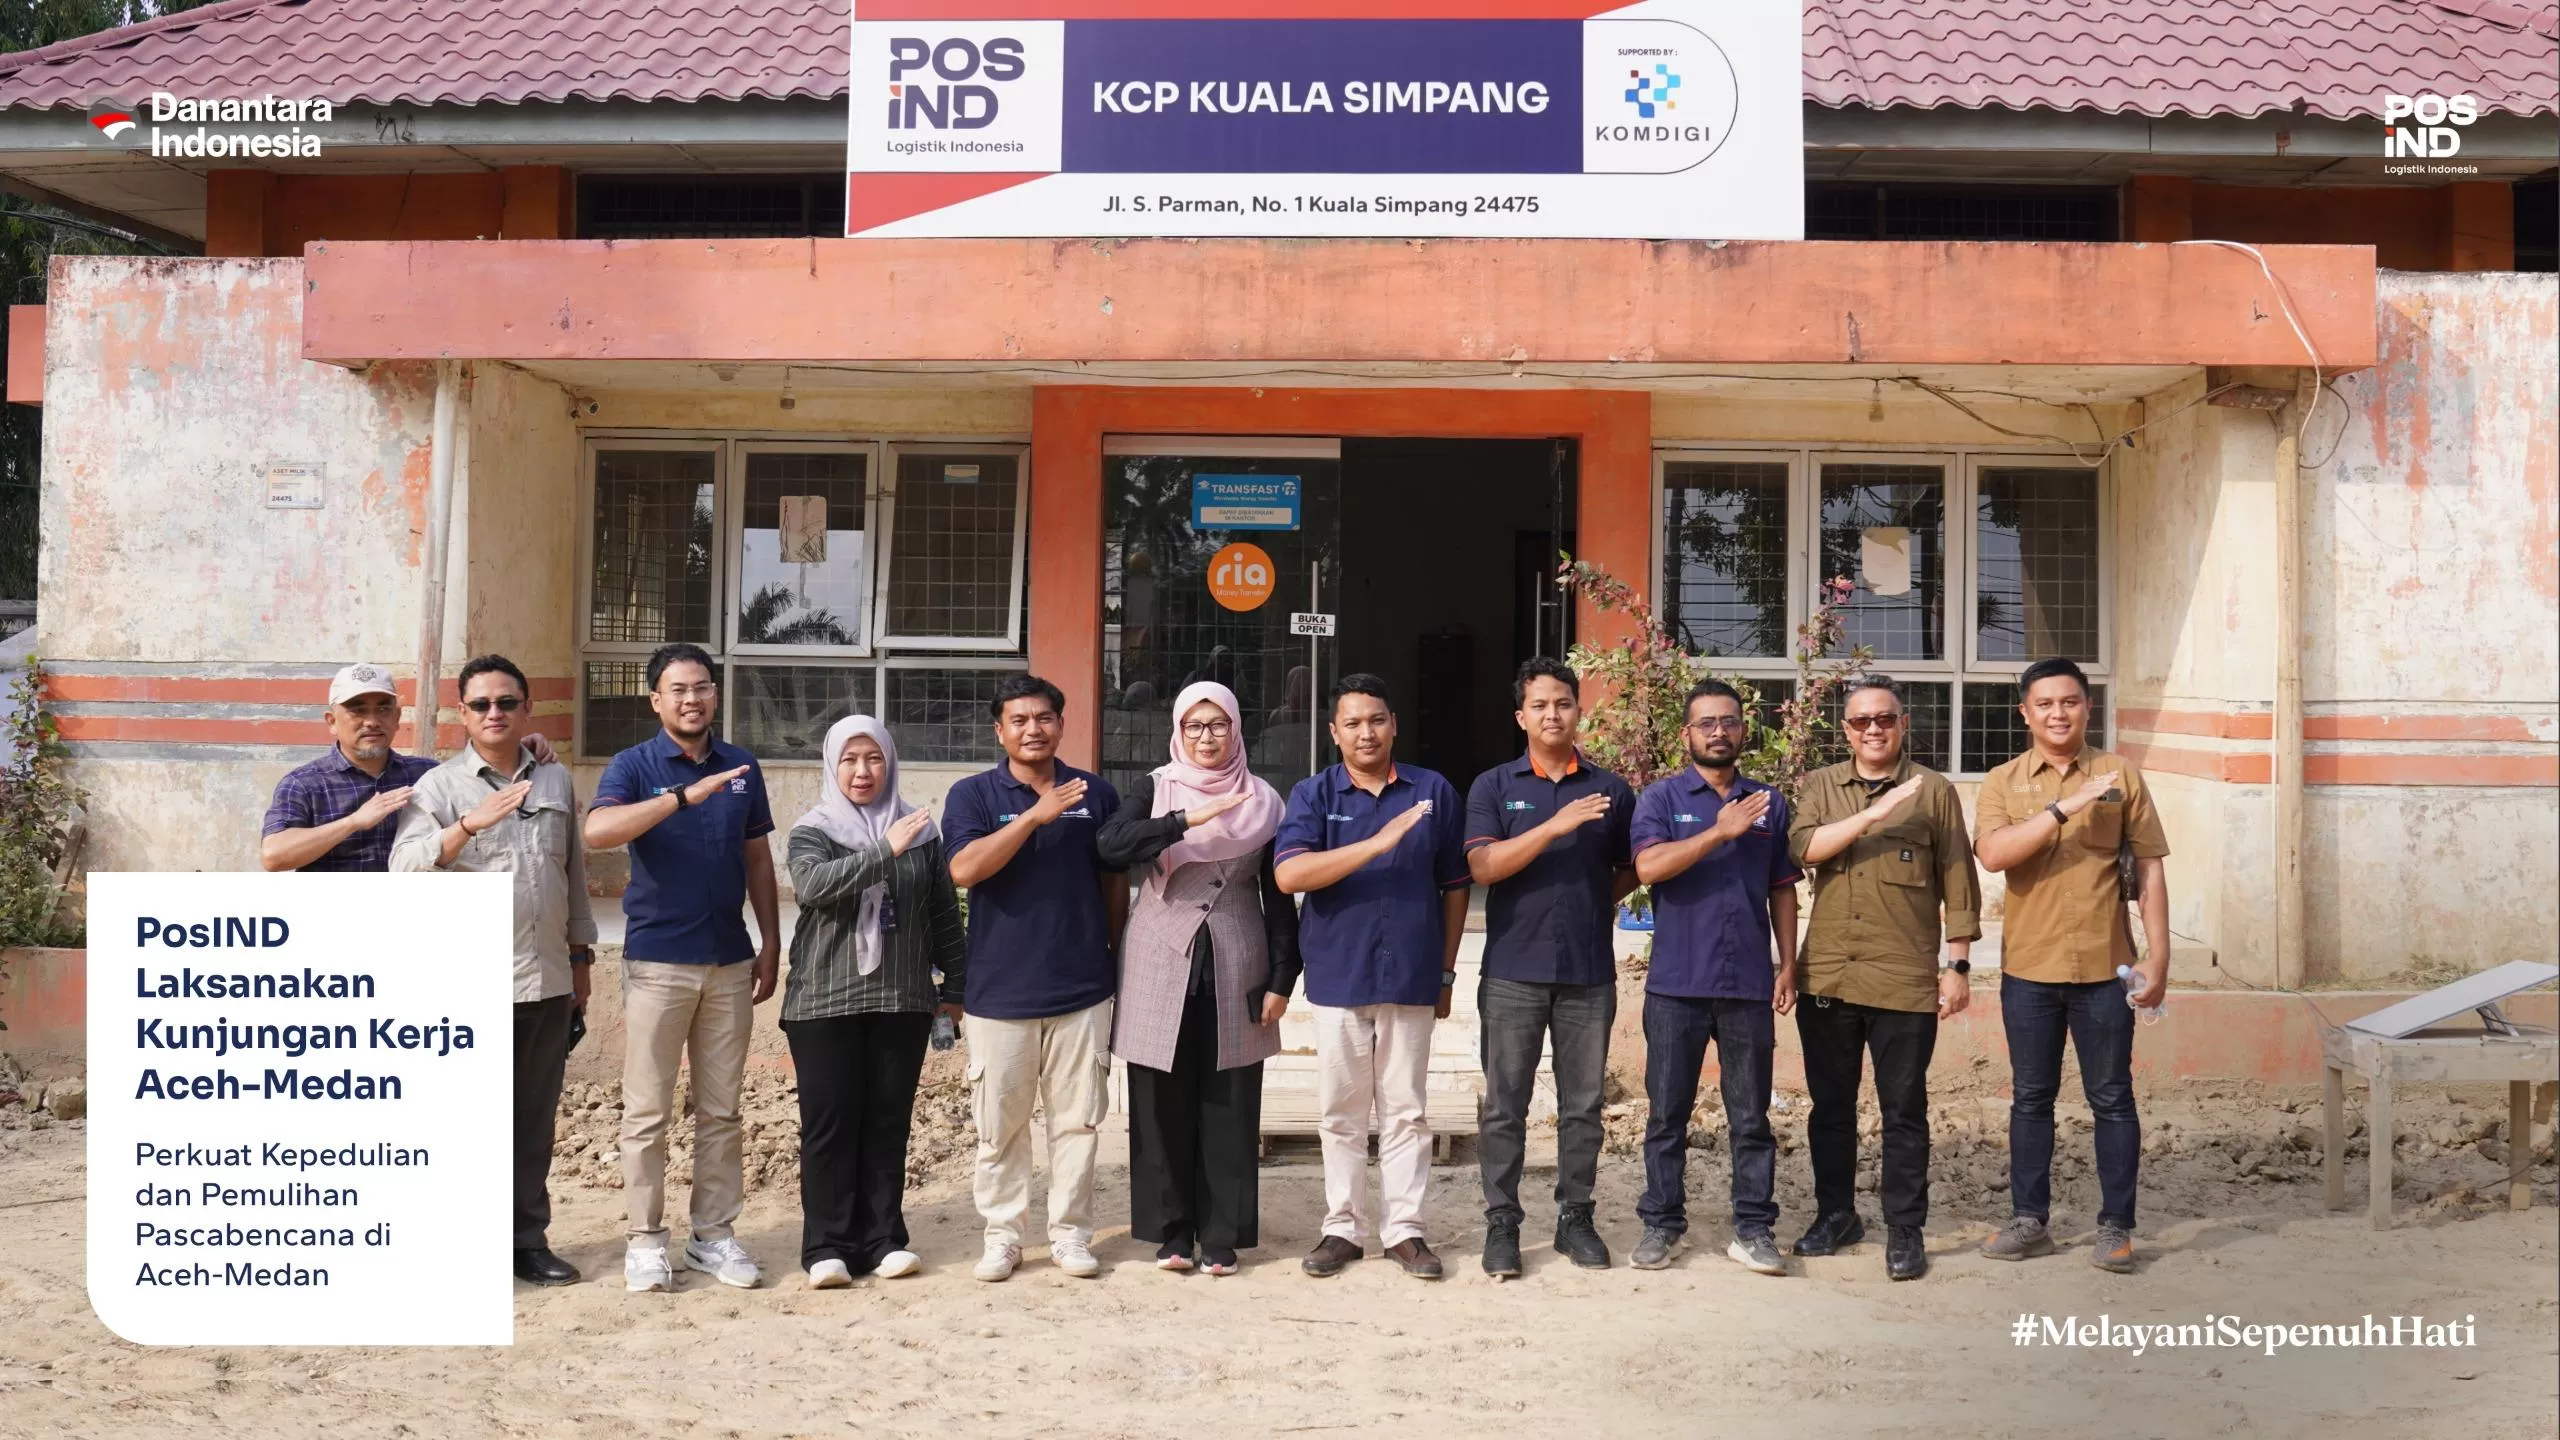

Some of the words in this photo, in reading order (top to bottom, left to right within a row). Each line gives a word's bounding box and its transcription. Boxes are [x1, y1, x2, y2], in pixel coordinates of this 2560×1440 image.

[890, 38, 1025, 81] POS
[1094, 81, 1179, 113] KCP
[1191, 81, 1333, 113] KUALA
[1344, 81, 1549, 113] SIMPANG
[1596, 126, 1709, 141] KOMDIGI
[888, 141, 946, 155] Logistik
[951, 141, 1023, 153] Indonesia
[1103, 196, 1125, 212] Jl.
[1134, 196, 1151, 212] S.
[1159, 196, 1244, 215] Parman,
[1253, 196, 1287, 212] No.
[1295, 196, 1302, 212] 1
[1310, 196, 1367, 213] Kuala
[1375, 196, 1467, 218] Simpang
[1474, 196, 1539, 213] 24475
[1216, 551, 1267, 586] ria
[1298, 615, 1327, 624] BUKA
[1298, 625, 1326, 634] OPEN
